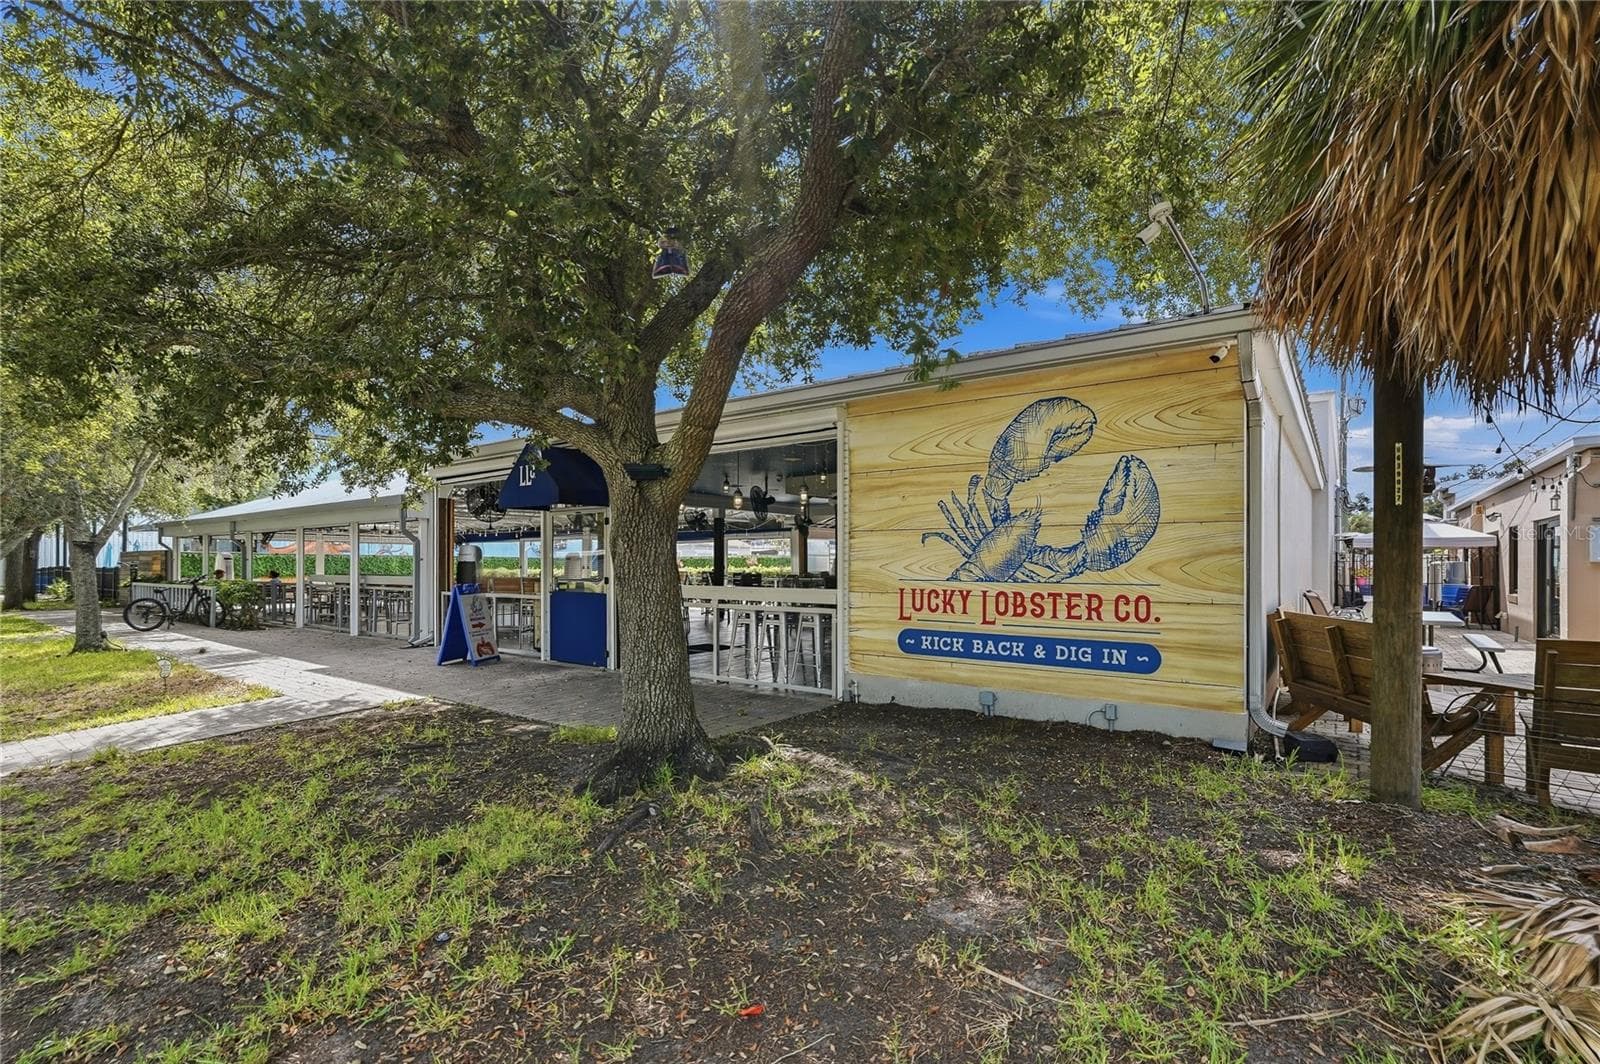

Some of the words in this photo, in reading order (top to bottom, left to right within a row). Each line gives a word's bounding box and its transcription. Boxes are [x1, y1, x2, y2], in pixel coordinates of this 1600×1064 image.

[898, 587, 972, 621] LUCKY
[980, 590, 1104, 626] LOBSTER
[1114, 594, 1161, 624] CO.
[921, 636, 964, 652] KICK
[972, 639, 1025, 657] BACK
[1033, 644, 1046, 659] &
[1055, 645, 1092, 663] DIG
[1102, 648, 1127, 666] IN
